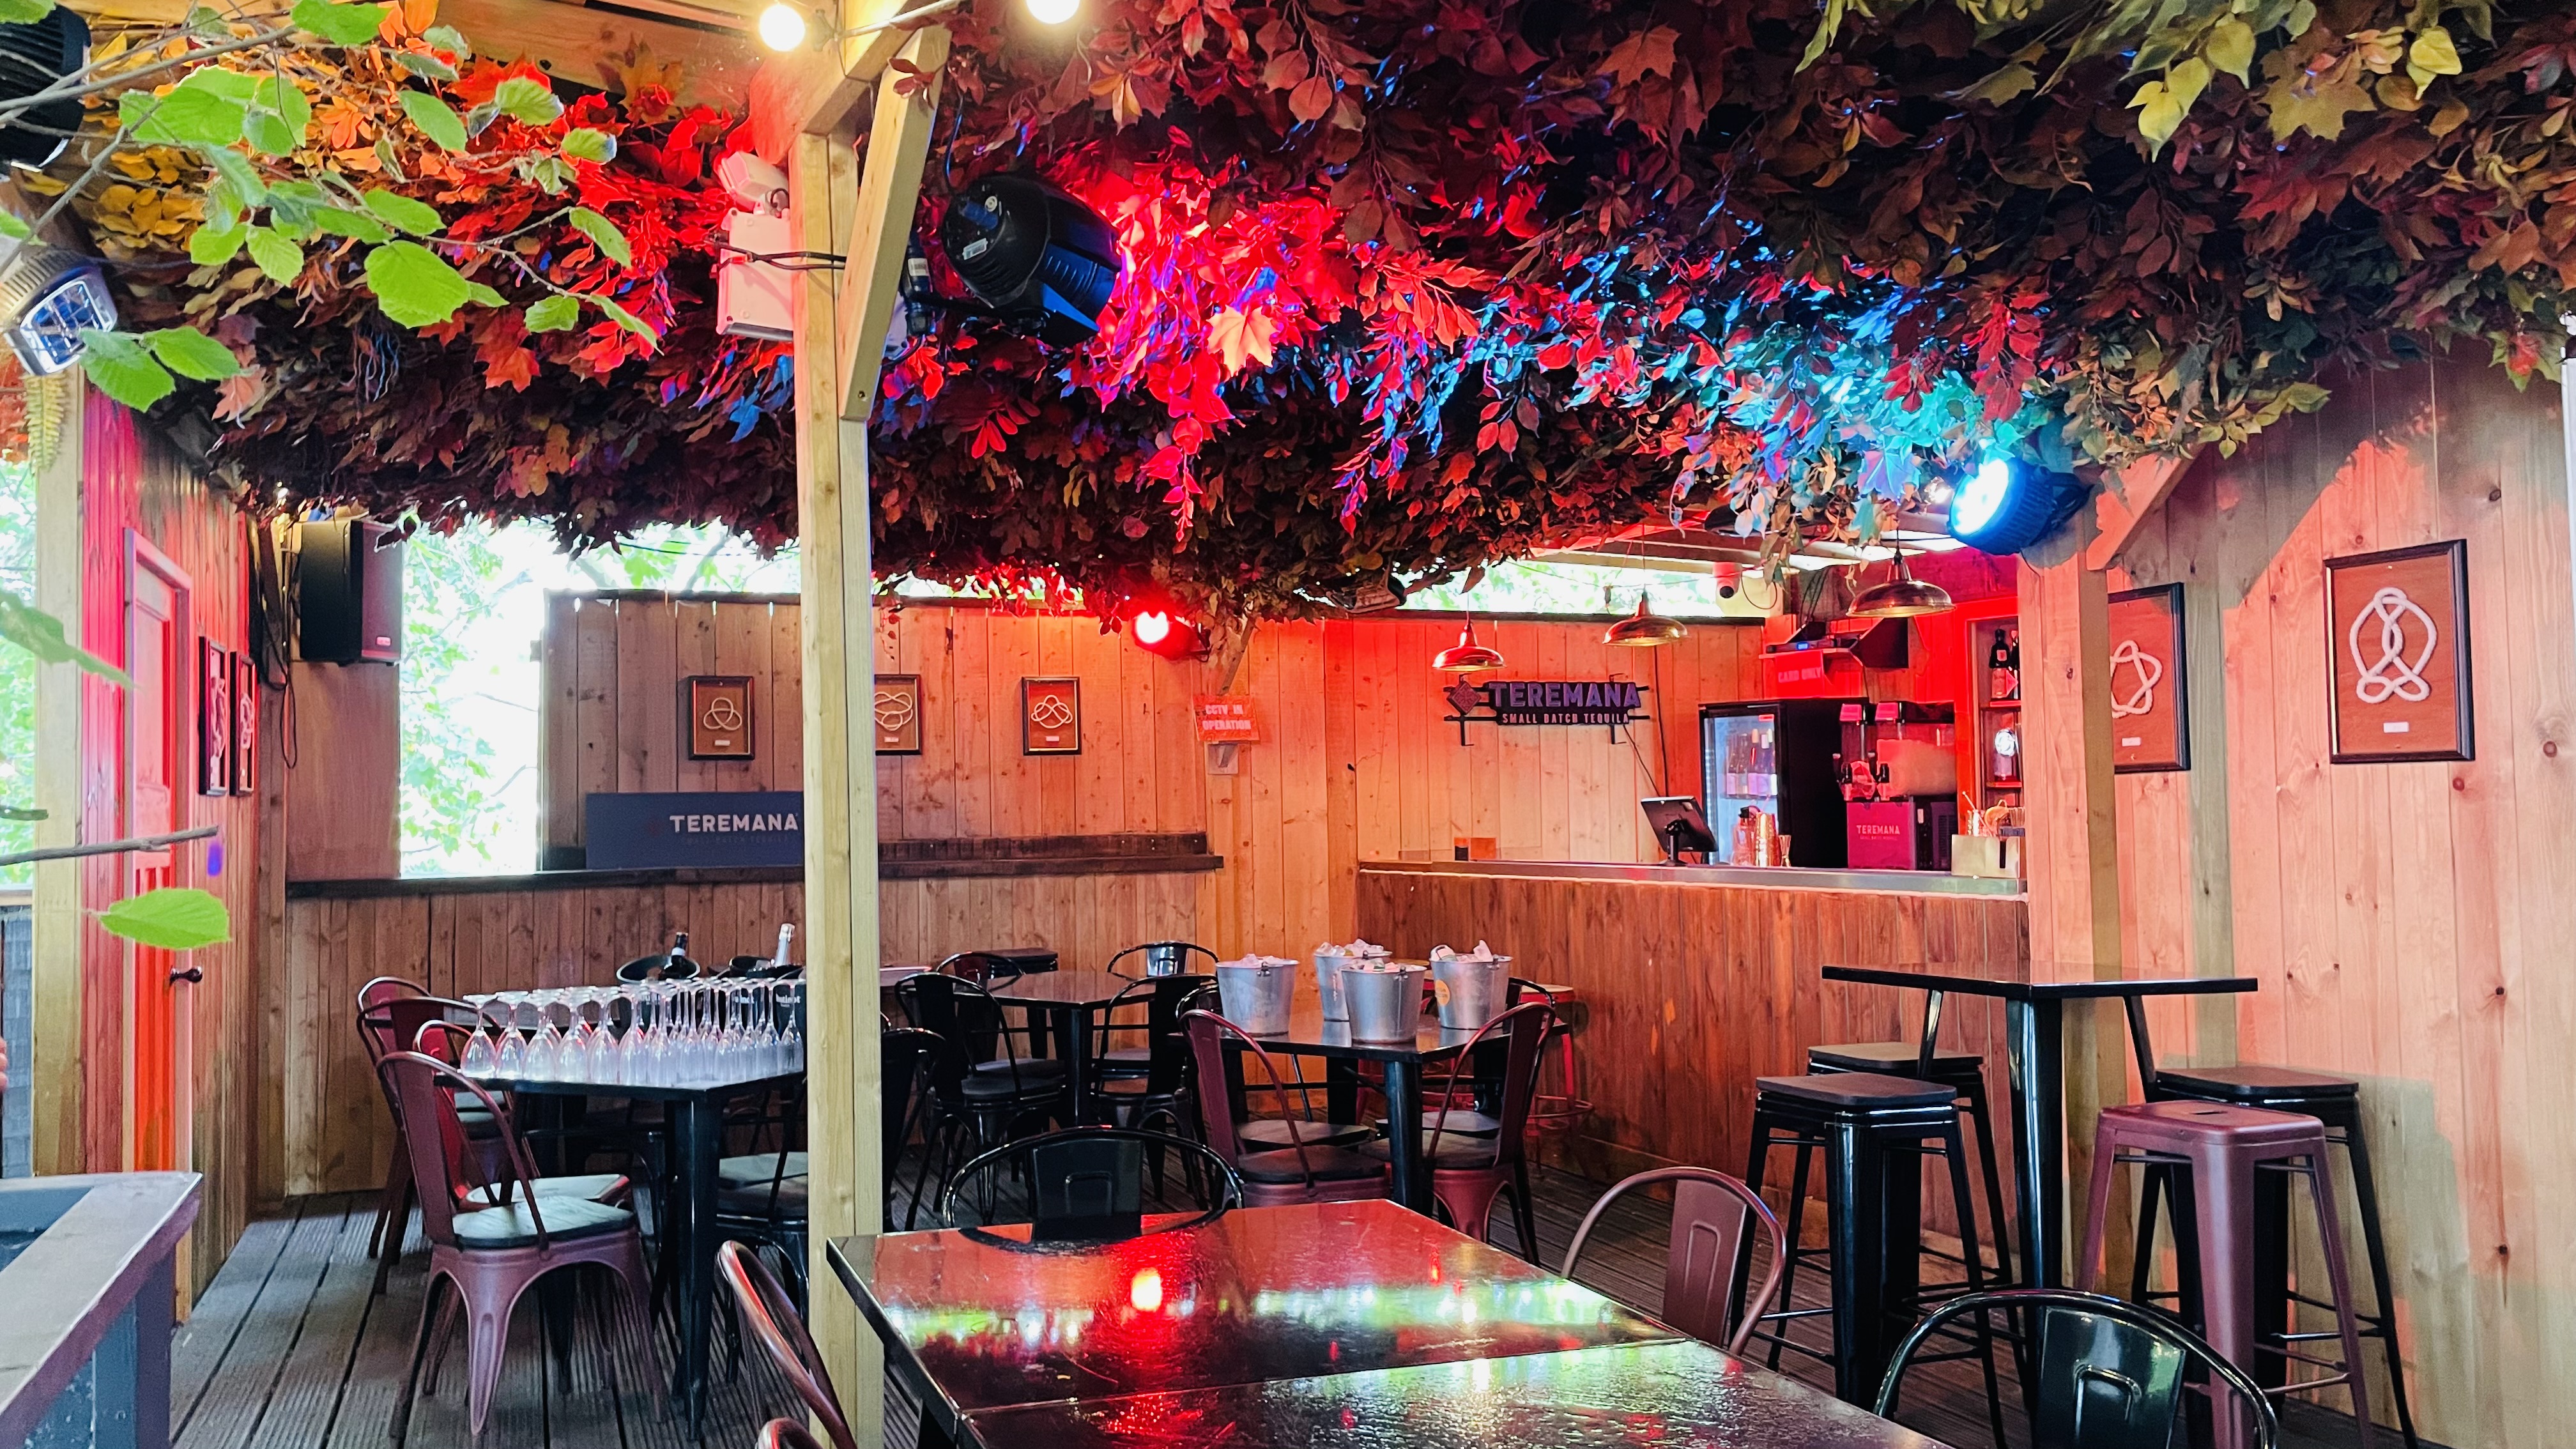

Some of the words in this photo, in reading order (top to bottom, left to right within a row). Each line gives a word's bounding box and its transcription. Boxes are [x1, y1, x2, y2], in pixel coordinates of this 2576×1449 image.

[1489, 682, 1641, 708] TEREMANA
[1205, 704, 1228, 714] CCTV
[1233, 704, 1243, 714] IN
[1503, 714, 1537, 723] SMALL
[1544, 714, 1578, 723] BATCH
[1584, 714, 1629, 723] TEQUILA
[1202, 720, 1251, 730] OPERATION
[670, 813, 798, 833] TEREMANA
[1856, 825, 1900, 834] TEREMANA
